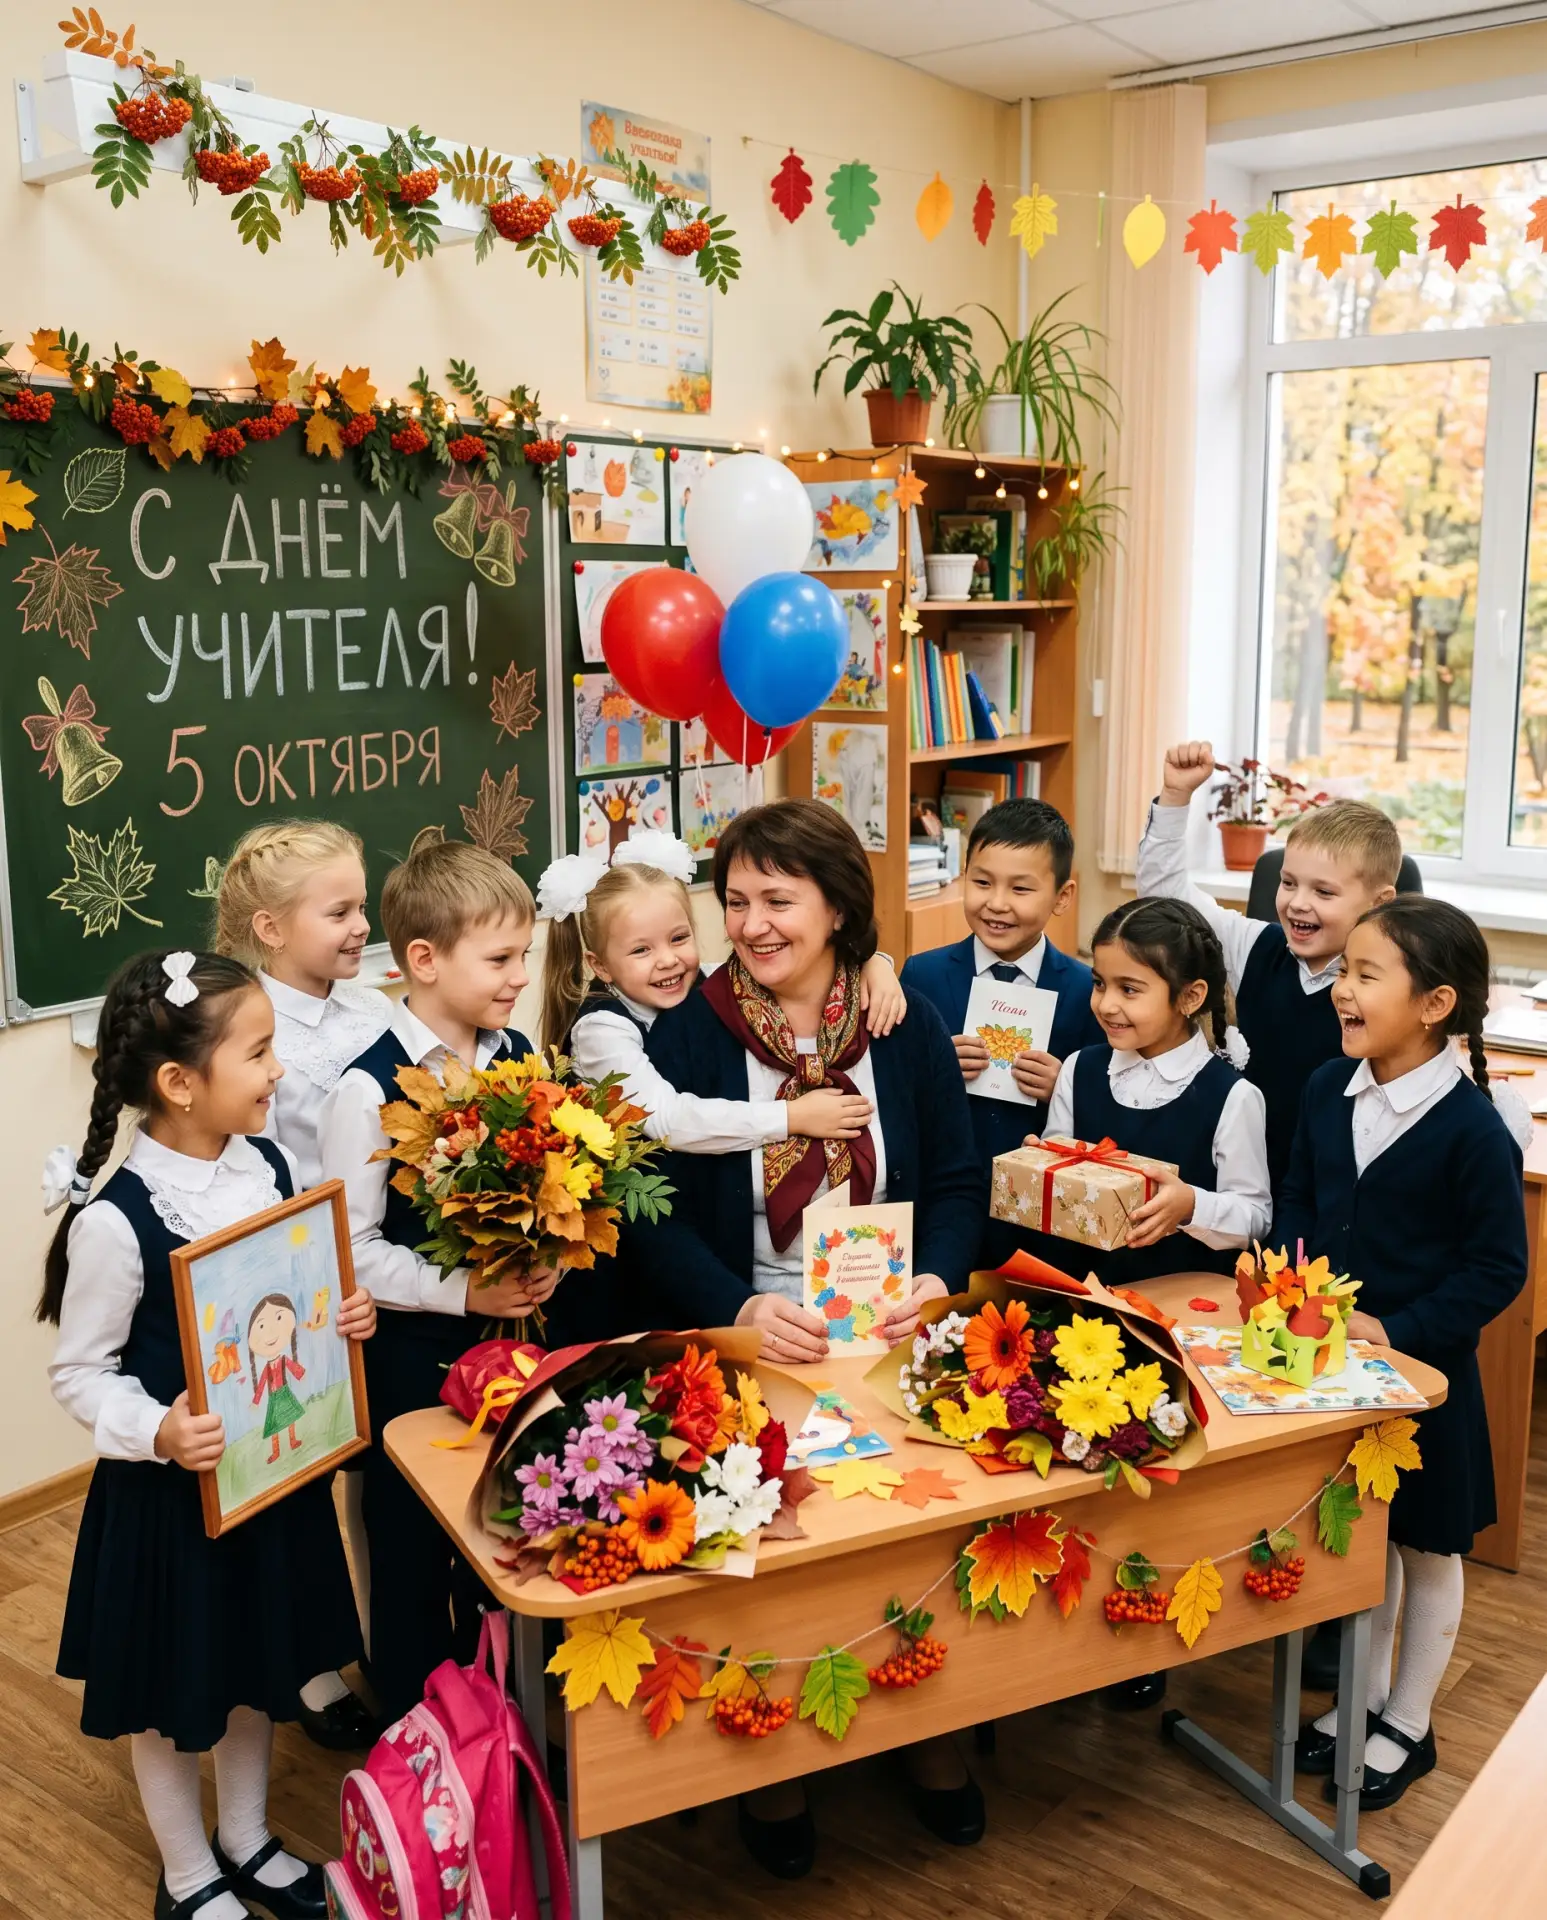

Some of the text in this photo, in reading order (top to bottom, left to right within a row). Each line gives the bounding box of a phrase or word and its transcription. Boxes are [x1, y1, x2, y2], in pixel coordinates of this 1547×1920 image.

[130, 483, 407, 585] С ДНЁМ
[137, 581, 479, 703] УЧИТЕЛЯ!
[159, 725, 441, 817] 5 ОКТЯБРЯ
